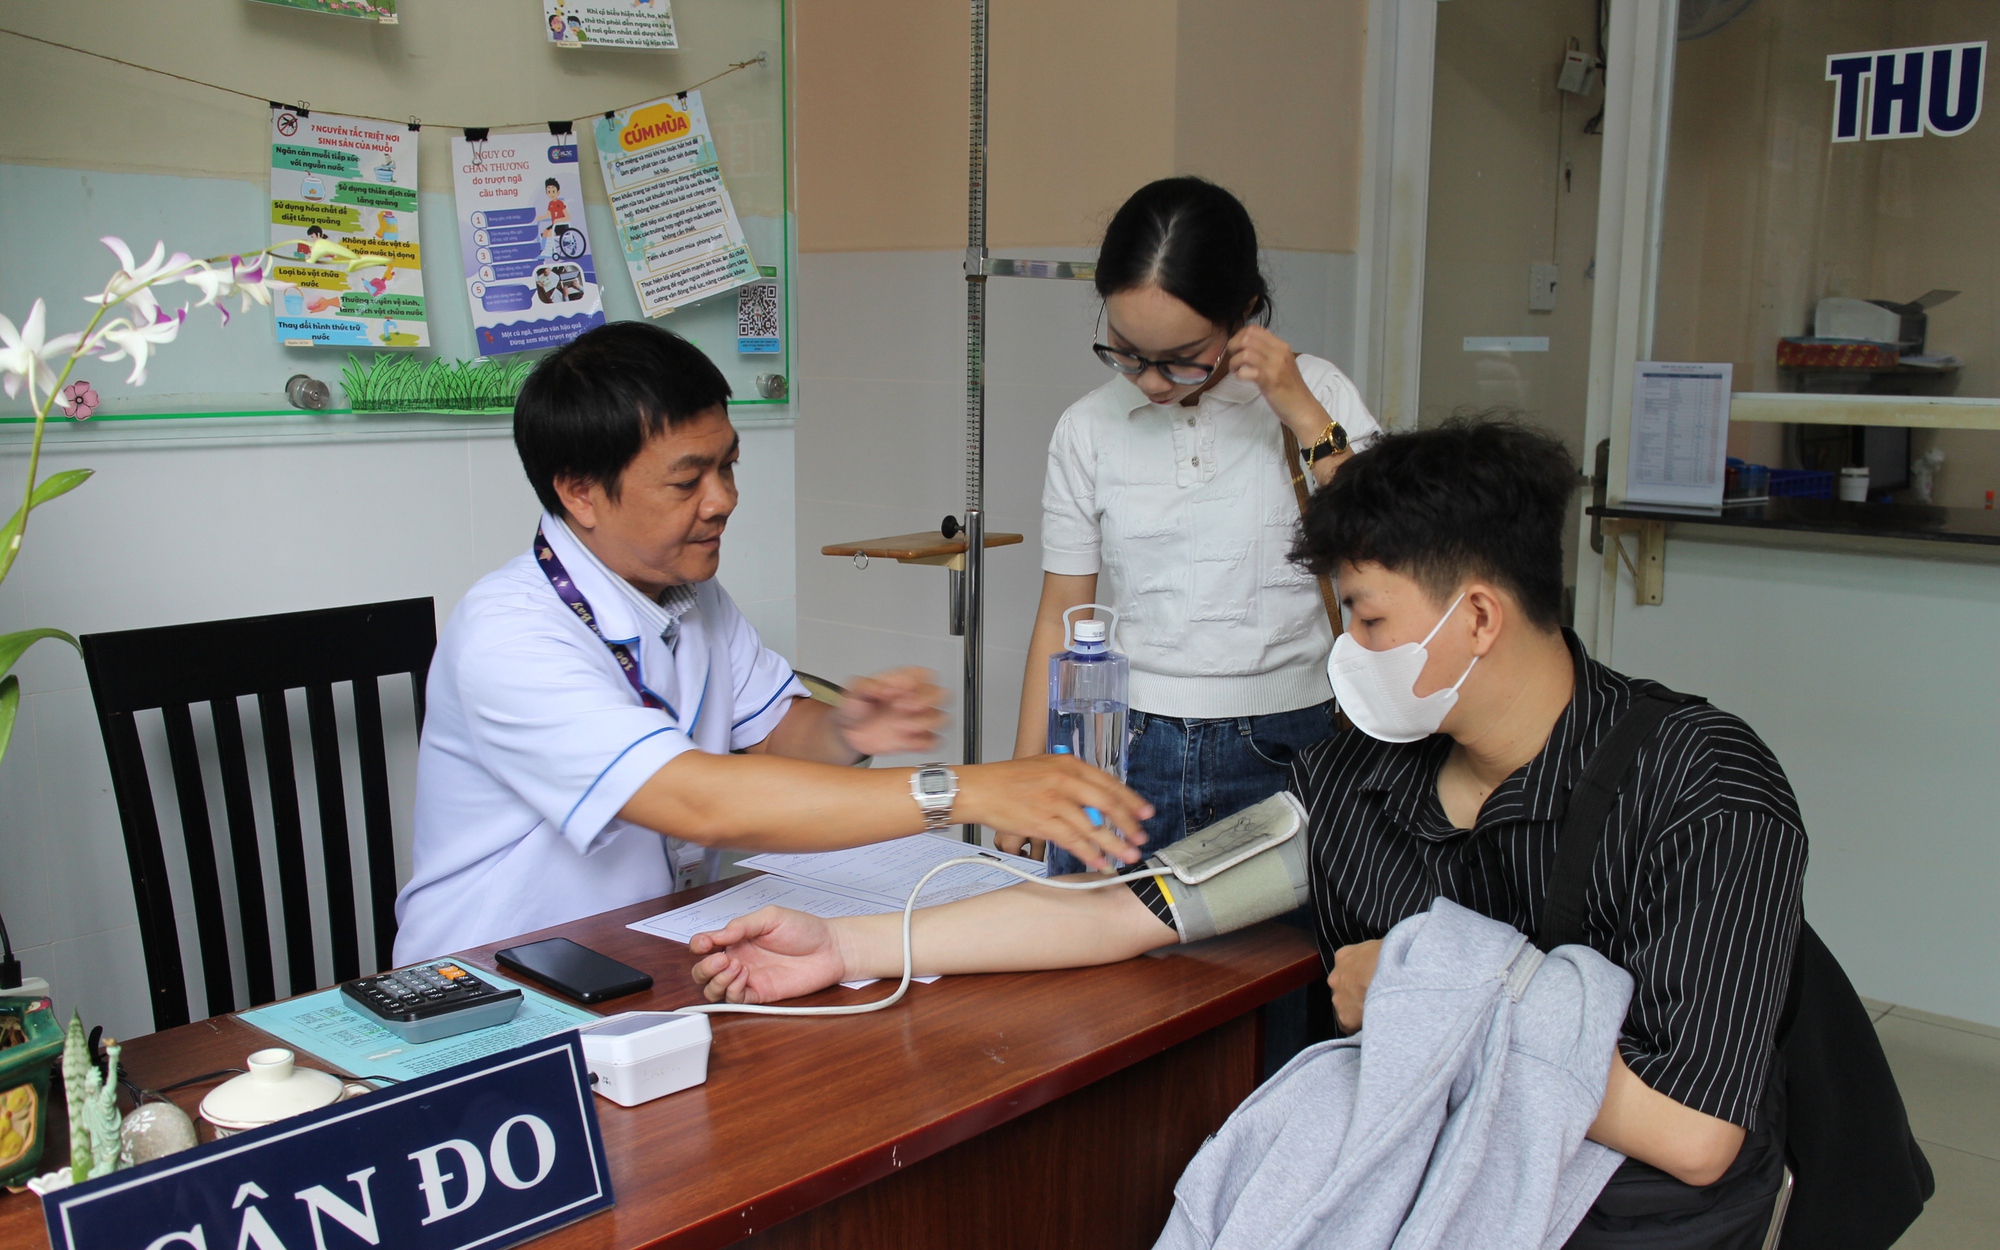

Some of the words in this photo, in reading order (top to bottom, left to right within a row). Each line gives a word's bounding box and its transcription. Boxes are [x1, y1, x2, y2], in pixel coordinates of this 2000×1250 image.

[1829, 45, 1984, 139] THU
[316, 123, 348, 136] NGUYÊN
[348, 125, 363, 137] TẮC
[363, 129, 384, 142] TRIỆT
[385, 134, 400, 142] NƠI
[624, 122, 654, 145] CÚM
[654, 114, 687, 136] MÙA
[318, 138, 337, 146] SINH
[338, 137, 354, 148] SẢN
[355, 139, 371, 150] CỦA
[372, 141, 393, 153] MUỖI
[276, 146, 297, 156] Ngăn
[298, 148, 311, 156] cản
[312, 149, 331, 159] muỗi
[332, 151, 346, 161] tiếp
[290, 158, 302, 166] với
[302, 159, 327, 170] nguồn
[327, 163, 345, 171] nước
[348, 185, 368, 194] dụng
[368, 187, 387, 195] thiên
[387, 189, 403, 198] địch
[284, 203, 305, 212] dụng
[321, 204, 337, 214] chất
[338, 206, 348, 214] để
[357, 196, 374, 205] lăng
[375, 198, 399, 208] quăng
[282, 213, 297, 222] diệt
[298, 214, 315, 224] lăng
[316, 216, 341, 226] quăng
[342, 236, 367, 246] Không
[368, 236, 377, 245] để
[390, 239, 402, 249] vật
[396, 251, 415, 260] đọng
[279, 268, 295, 277] Loại
[307, 270, 320, 278] vật
[393, 298, 401, 307] vệ
[374, 308, 385, 316] vật
[299, 320, 312, 328] đổi
[616, 651, 634, 671] 100
[407, 1114, 557, 1226] ĐO
